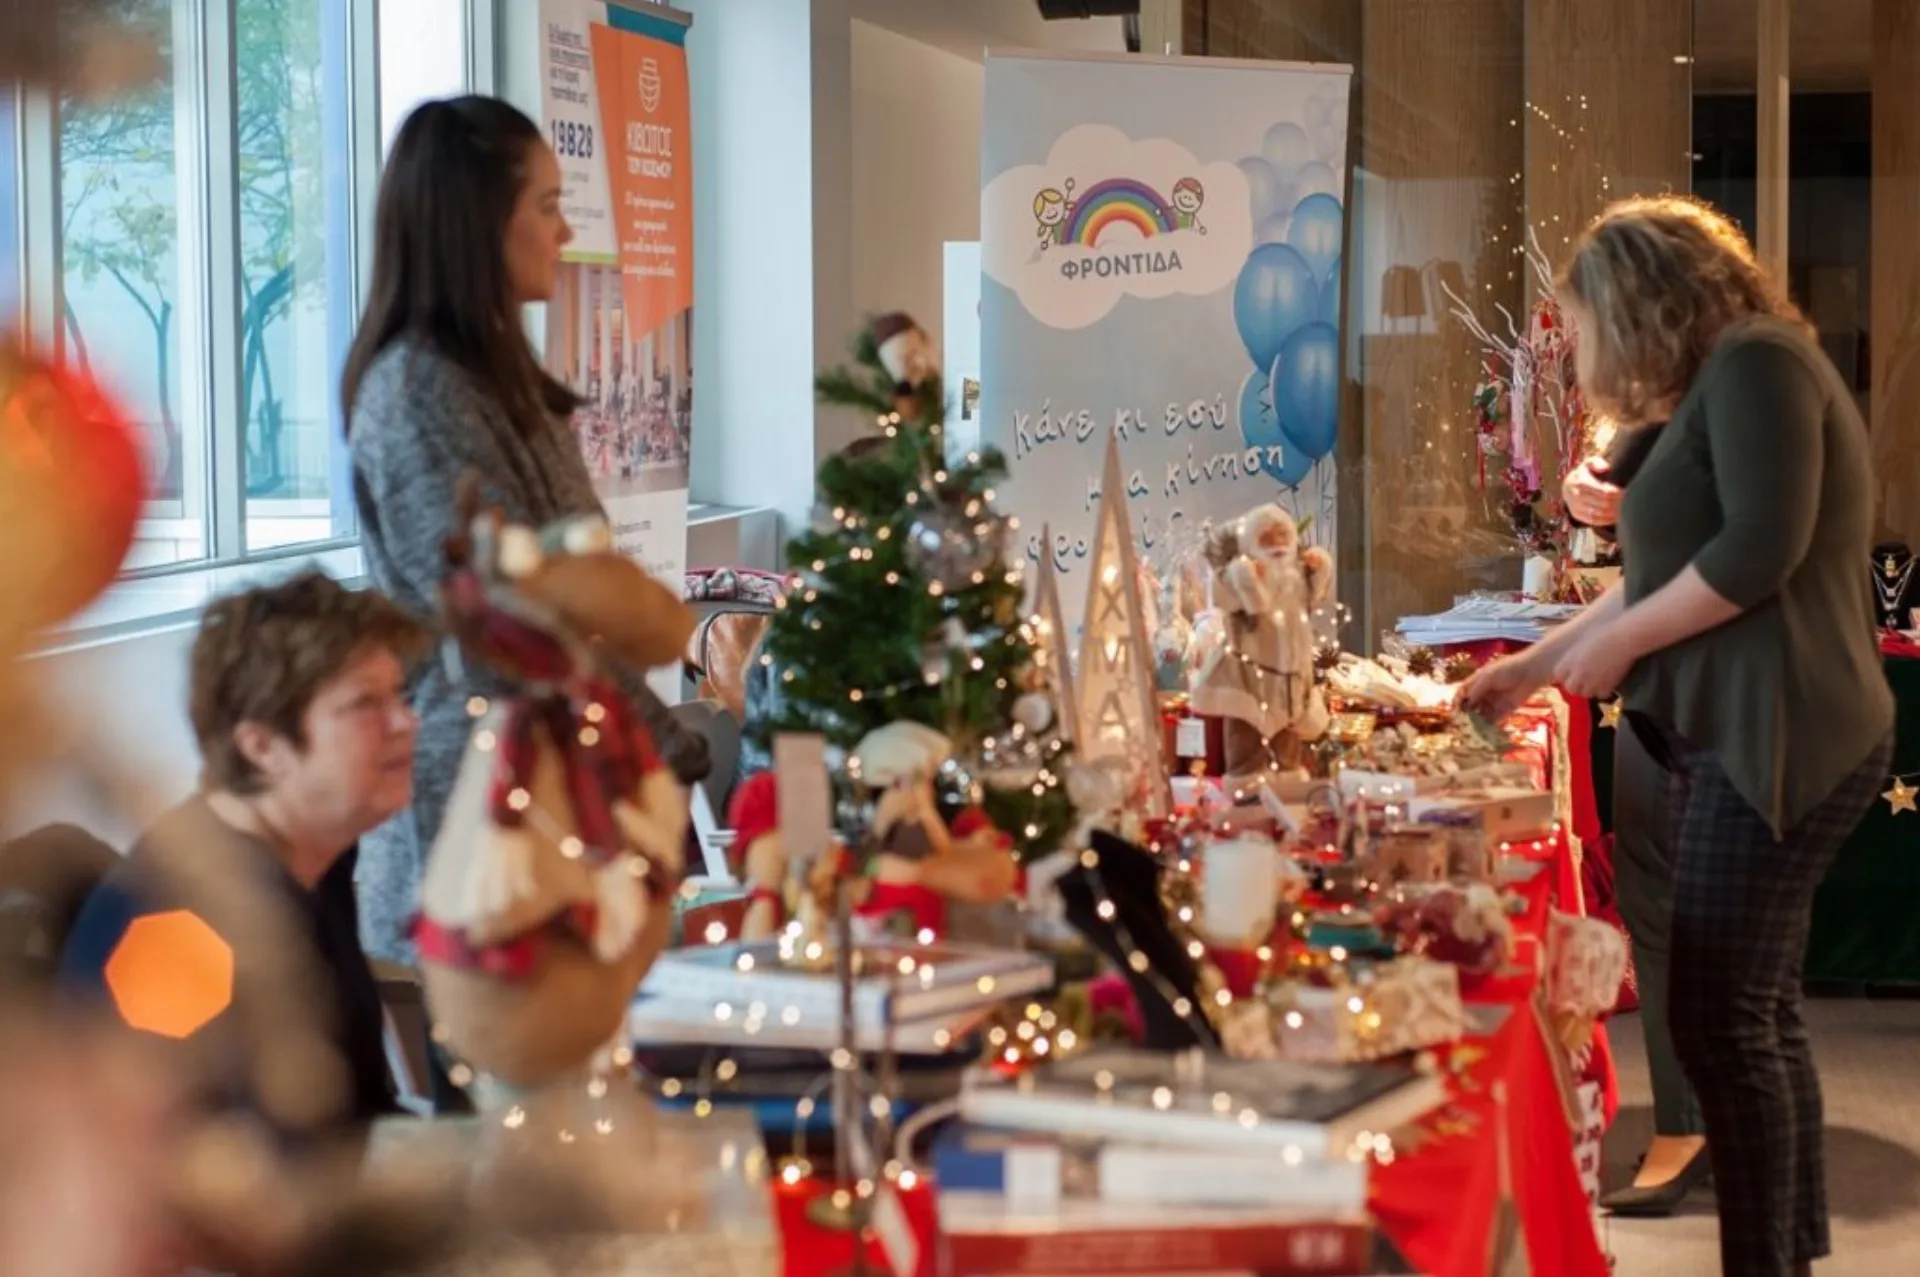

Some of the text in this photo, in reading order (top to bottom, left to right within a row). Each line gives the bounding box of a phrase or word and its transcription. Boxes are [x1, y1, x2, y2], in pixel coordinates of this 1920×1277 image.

[551, 118, 593, 160] 19828
[1060, 249, 1183, 281] ΦΡΟΝΤΙΔΑ
[1084, 443, 1286, 512] μα κίνηση
